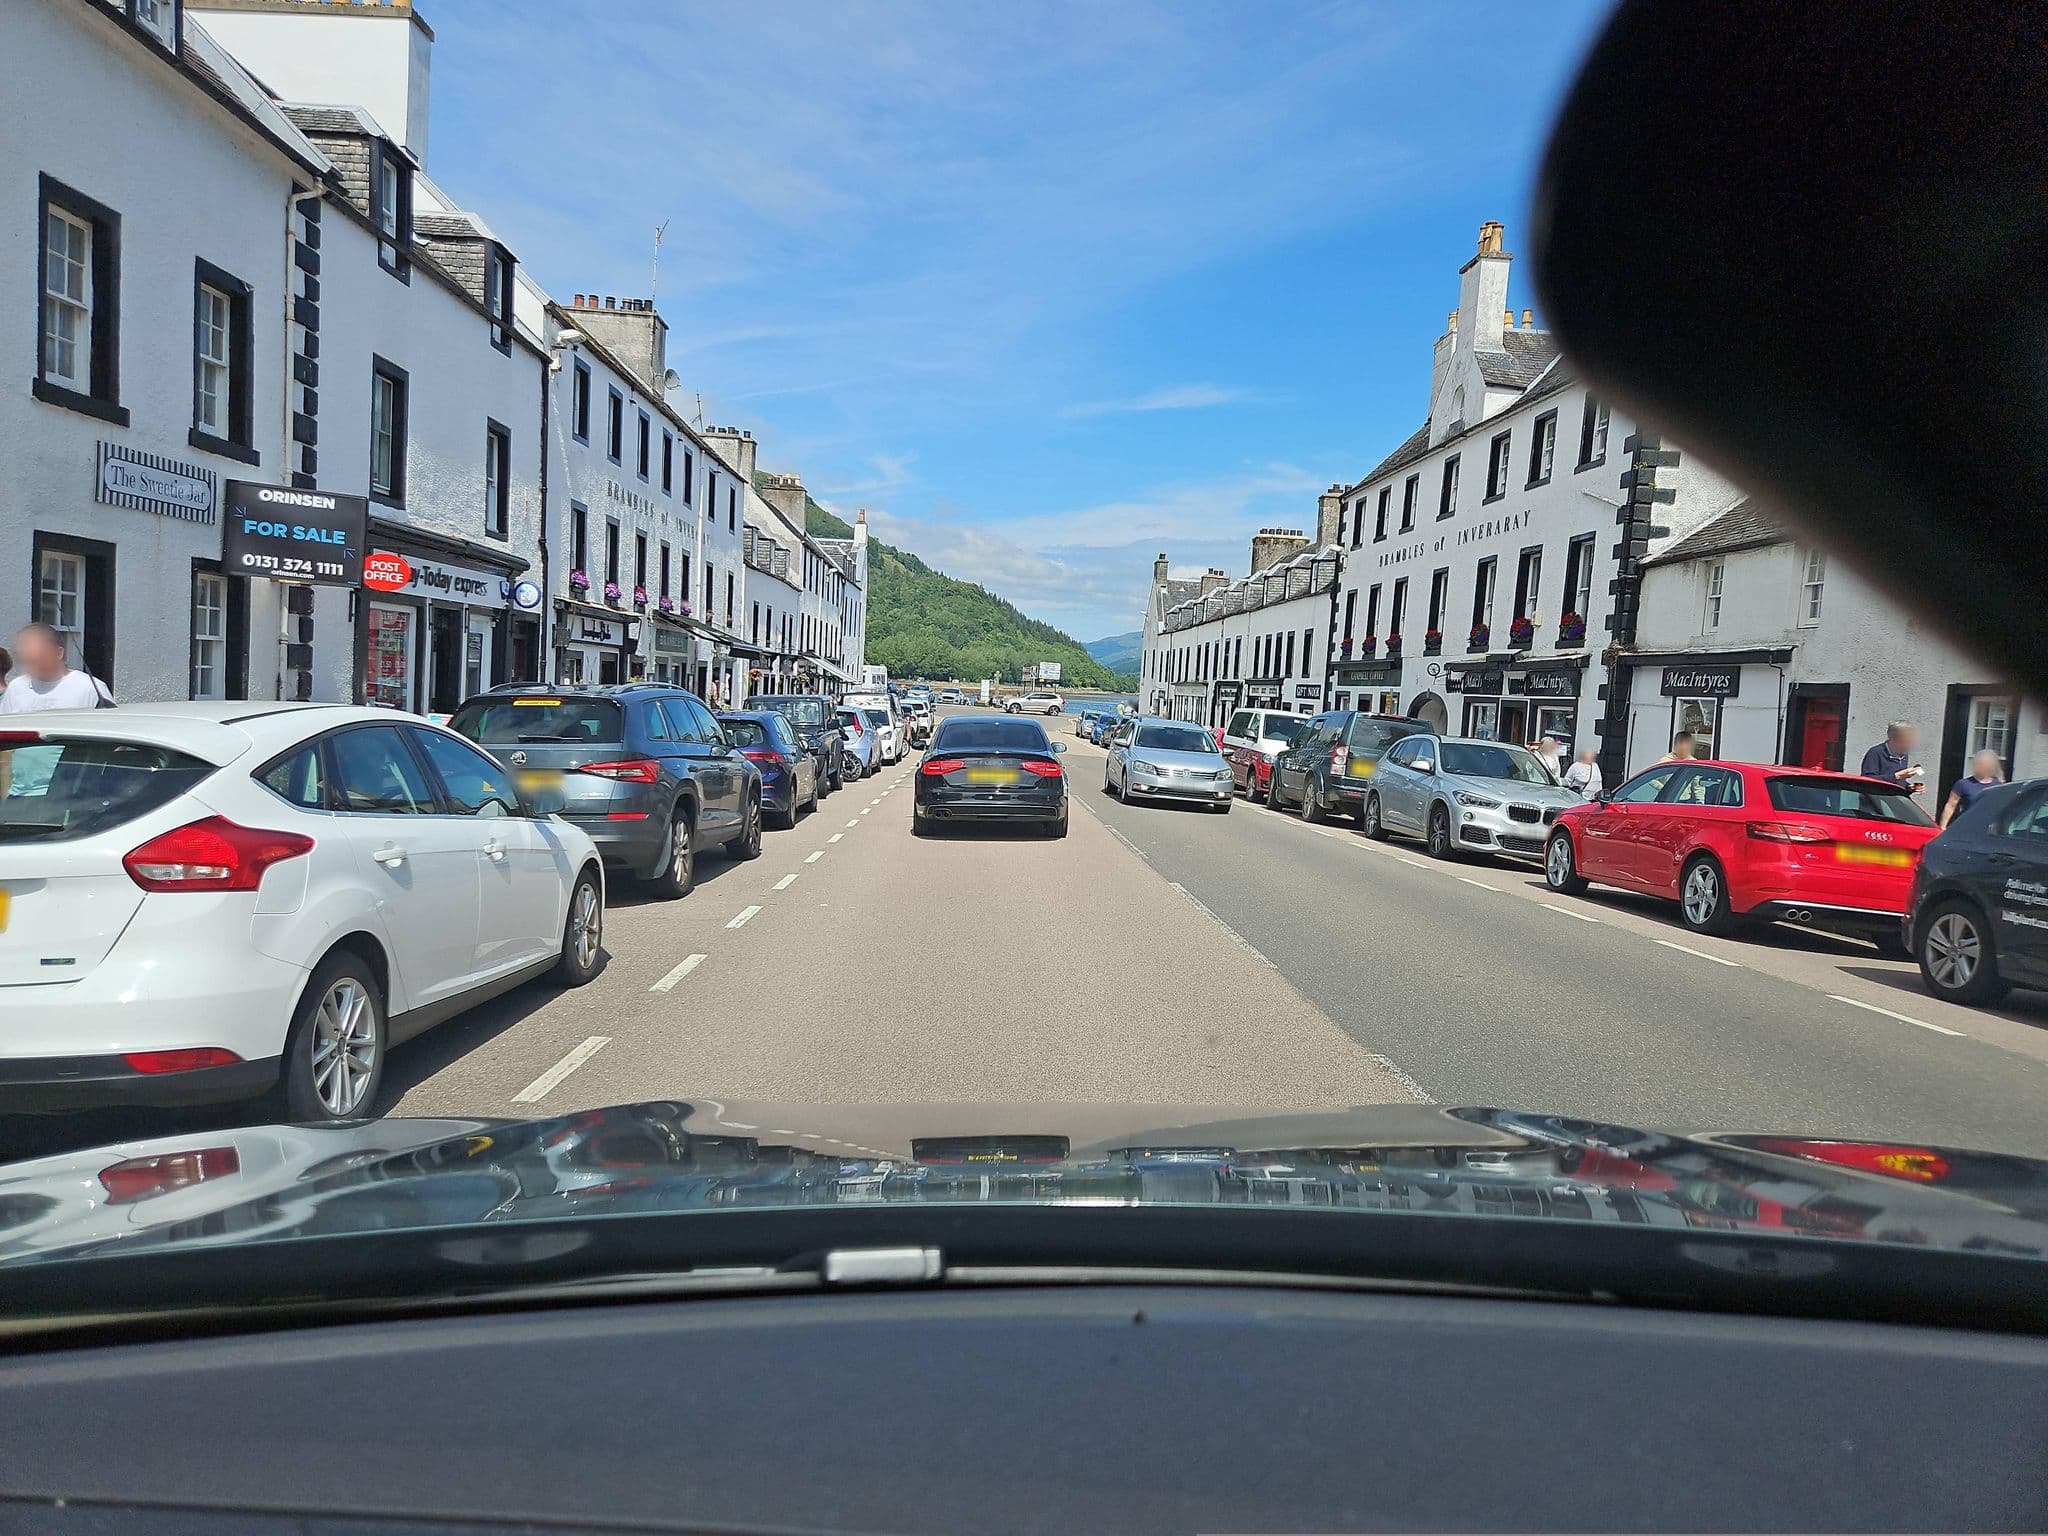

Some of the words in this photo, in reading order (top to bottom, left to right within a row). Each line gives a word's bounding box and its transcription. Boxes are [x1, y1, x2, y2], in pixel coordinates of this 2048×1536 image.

[110, 465, 136, 489] The
[140, 471, 184, 500] Sweetie
[187, 483, 206, 504] Jar
[258, 489, 336, 510] ORINSEN
[244, 519, 288, 539] FOR
[293, 525, 346, 545] SALE
[1379, 543, 1425, 568] BRAMBLES
[1434, 536, 1445, 552] of
[1457, 510, 1531, 546] INVERARAY
[242, 553, 279, 569] 0131
[283, 558, 313, 573] 374
[317, 562, 344, 576] 1111
[271, 569, 315, 580] orinsen.com
[371, 560, 401, 572] POST
[364, 570, 405, 583] OFFICE
[455, 575, 488, 597] express
[1665, 671, 1731, 693] MacIntyres
